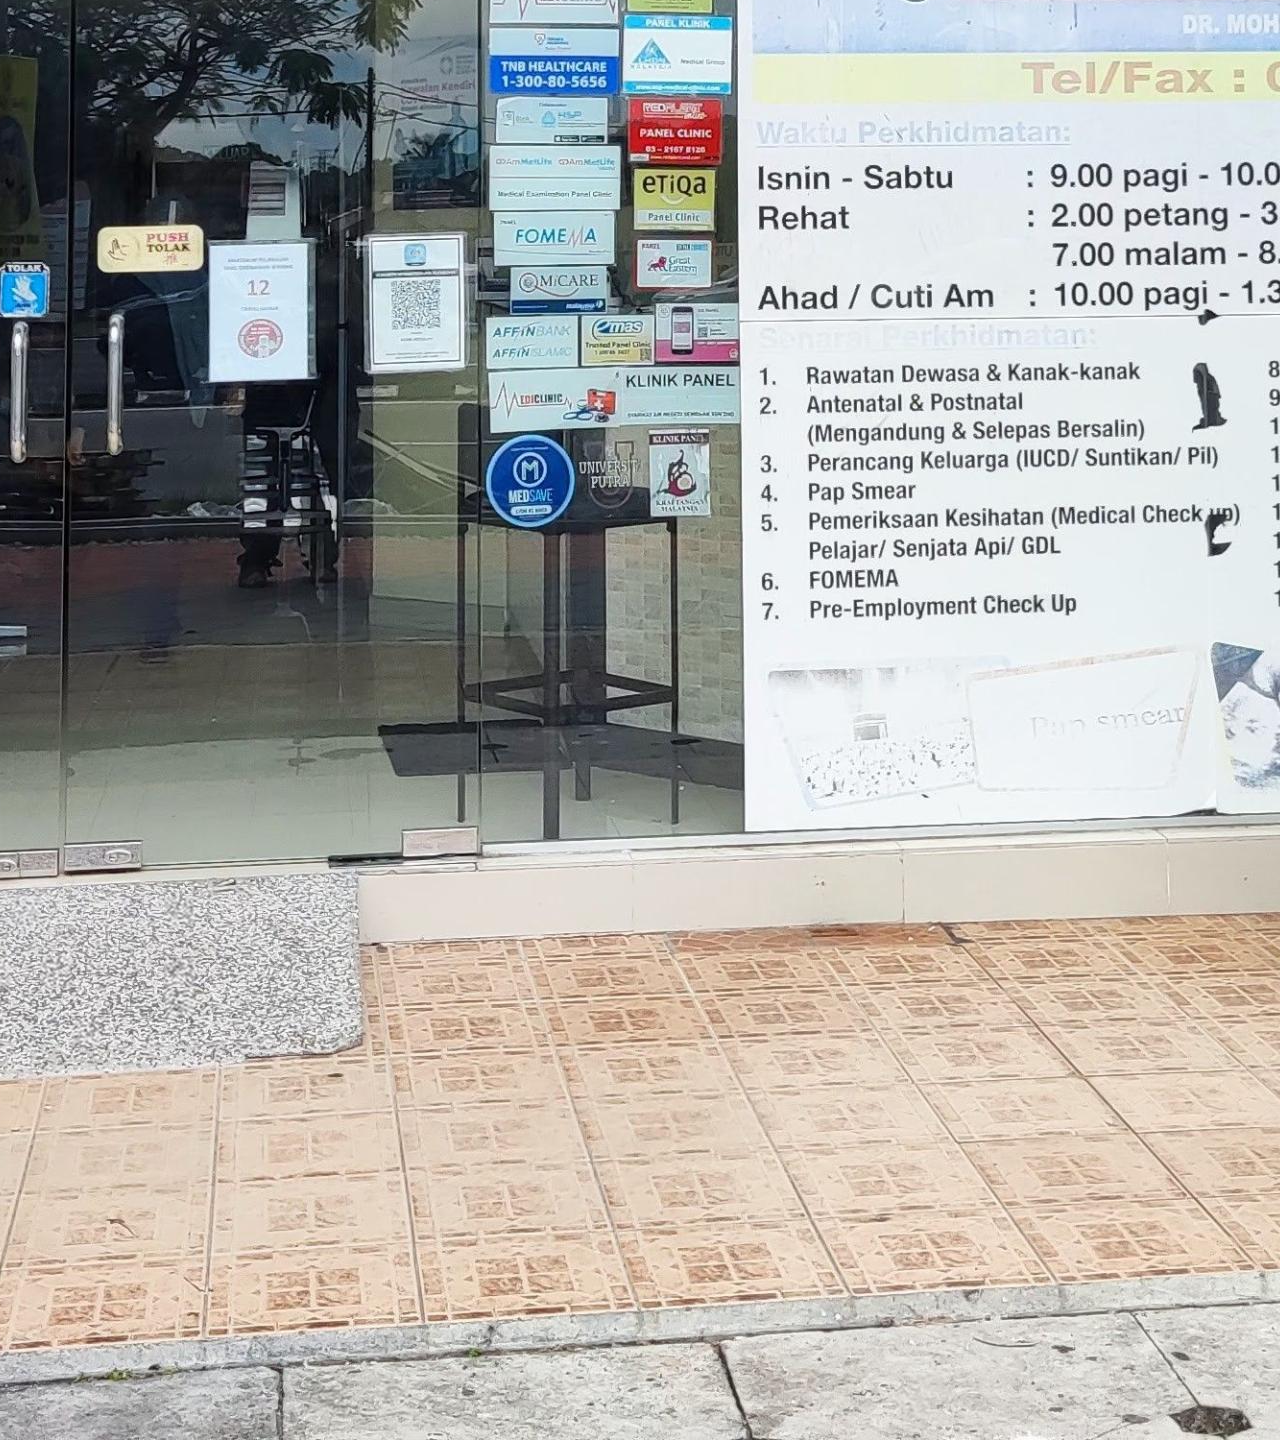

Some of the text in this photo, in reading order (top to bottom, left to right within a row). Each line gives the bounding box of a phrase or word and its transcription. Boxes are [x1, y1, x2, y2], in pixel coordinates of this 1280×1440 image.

[646, 19, 710, 30] PANEL KLINIK
[1182, 13, 1219, 35] DR.
[501, 61, 607, 73] TNB HEALTHCARE
[1022, 61, 1214, 95] Tel/Fax
[502, 75, 607, 88] 1-300-80-5656
[640, 128, 712, 139] PANEL CLINIC
[756, 120, 1071, 145] Waktu Perkhidmatan:
[757, 165, 830, 191] Isnin
[864, 164, 953, 190] Sabtu
[1050, 163, 1113, 188] 9.00
[1123, 162, 1188, 192] pagi
[648, 213, 700, 222] Panel Clinic
[758, 205, 850, 231] Rehat
[1051, 203, 1114, 228] 2.00
[1124, 202, 1229, 232] petang
[146, 232, 189, 243] PUSH
[147, 243, 190, 252] TOLAK
[516, 226, 597, 248] FOMEMA
[1052, 242, 1115, 268] 7.00
[1125, 241, 1227, 266] malam
[6, 263, 43, 273] TOLAK
[247, 279, 271, 296] 12
[540, 273, 600, 288] MiCARE
[758, 285, 839, 310] Ahad
[870, 283, 933, 309] Cuti
[943, 283, 995, 308] Am
[1054, 282, 1133, 307] 10.00
[1144, 280, 1209, 310] pagi
[626, 373, 735, 388] KLINIK PANEL
[806, 361, 1141, 386] Rawatan Dewasa Kanak-kanak
[807, 391, 1023, 414] Antenatal Postnatal
[652, 435, 679, 444] KLINIK
[808, 419, 1145, 447] (Mengandung Selepas Bersalin)
[808, 446, 1218, 474] Perancang Keluarga (IUCD/ Suntikan/ Pil)
[591, 475, 630, 489] PUTRA
[808, 481, 916, 505] Pap Smear
[508, 488, 553, 504] MEDSAVE
[809, 504, 1203, 531] Pemeriksaan Kesihatan (Medical Check
[809, 536, 1061, 563] Pelajar/ Senjata Api/ GDL
[809, 569, 900, 590] FOMEMA
[810, 594, 1077, 620] Pre-Employment Check Up
